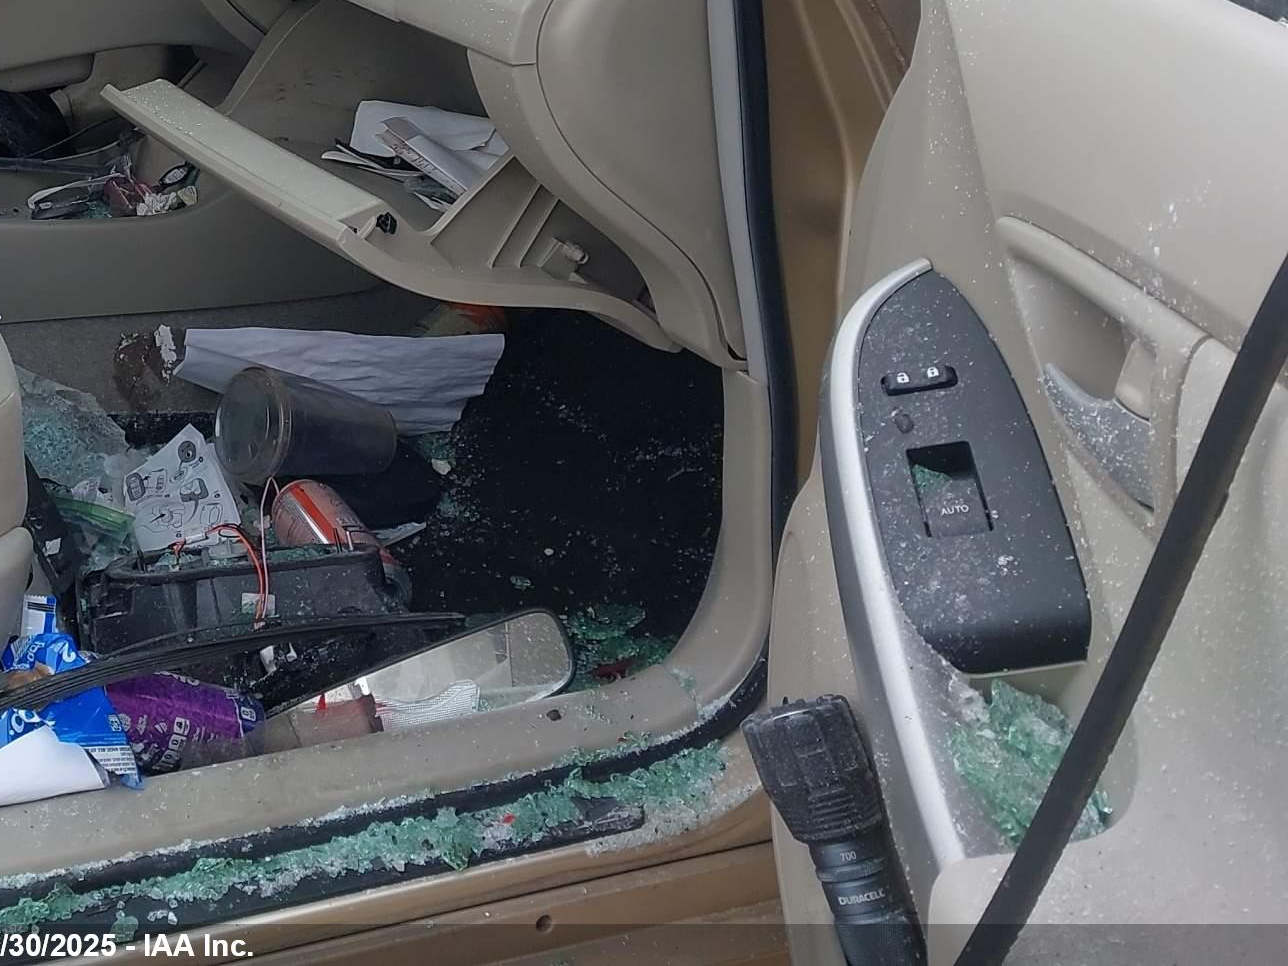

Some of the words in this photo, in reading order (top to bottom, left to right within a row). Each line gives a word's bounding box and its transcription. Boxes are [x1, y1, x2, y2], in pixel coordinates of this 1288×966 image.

[941, 505, 969, 516] AUTO
[840, 851, 857, 862] 700
[838, 889, 885, 906] DURACELL
